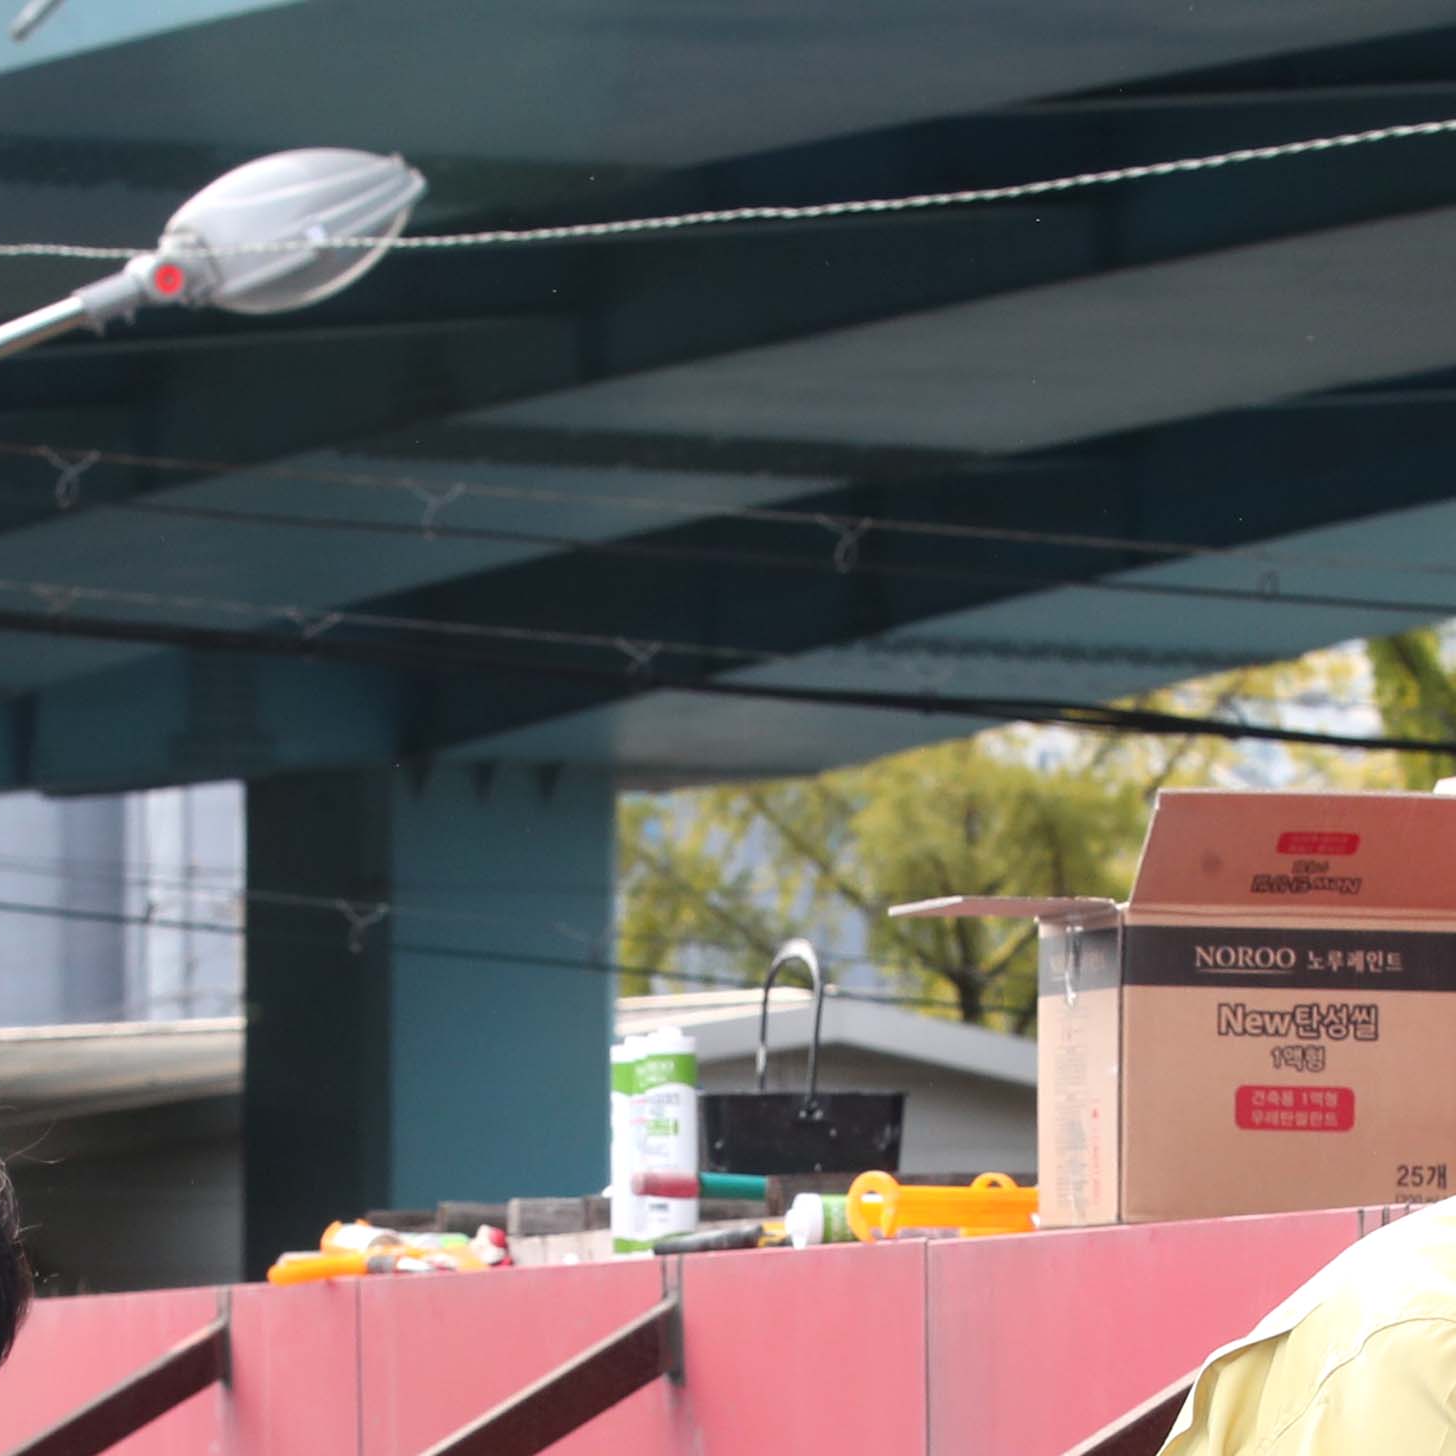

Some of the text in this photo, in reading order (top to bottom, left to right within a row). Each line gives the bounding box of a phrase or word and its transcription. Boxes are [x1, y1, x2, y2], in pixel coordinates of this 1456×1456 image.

[1195, 945, 1404, 973] NOROO 노루페인트
[1217, 1002, 1379, 1041] New탄성씰
